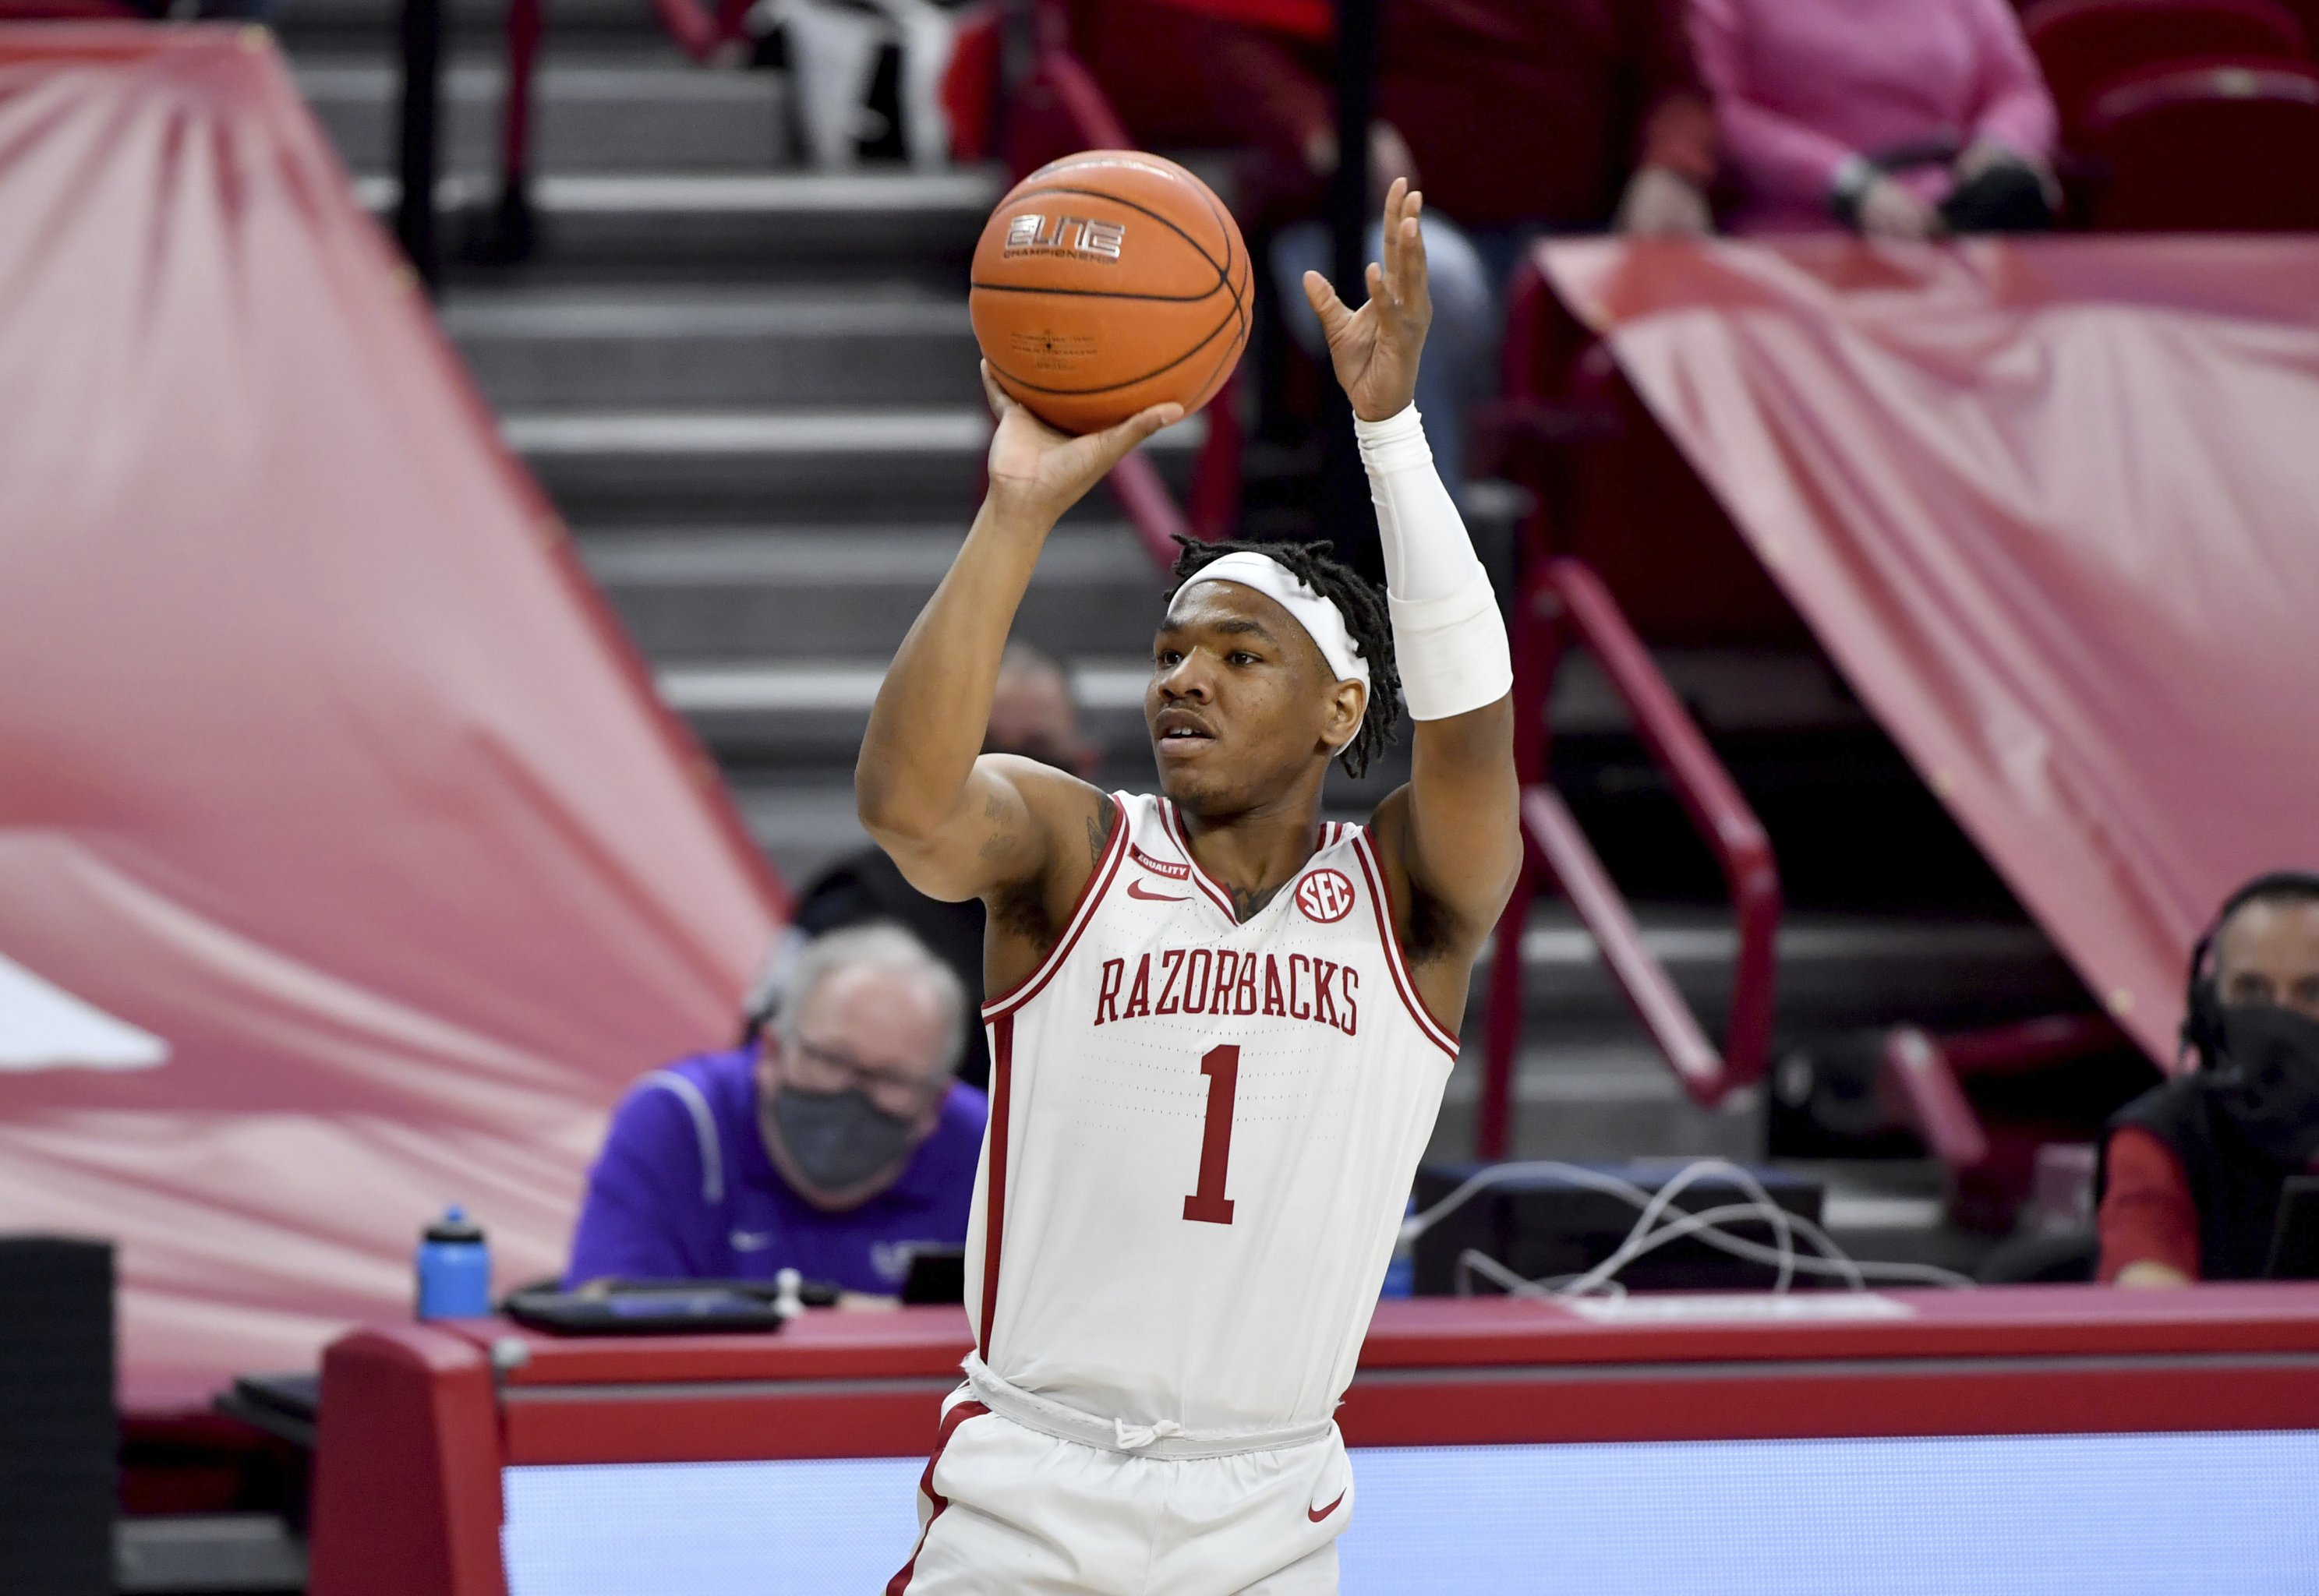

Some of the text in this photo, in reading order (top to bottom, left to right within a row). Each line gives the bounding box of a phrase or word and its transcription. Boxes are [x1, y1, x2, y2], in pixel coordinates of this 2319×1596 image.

[1138, 854, 1186, 876] EQUALITY
[1299, 872, 1350, 920] SEC
[1094, 948, 1359, 1036] RAZORBACKS
[1182, 1044, 1240, 1225] 1
